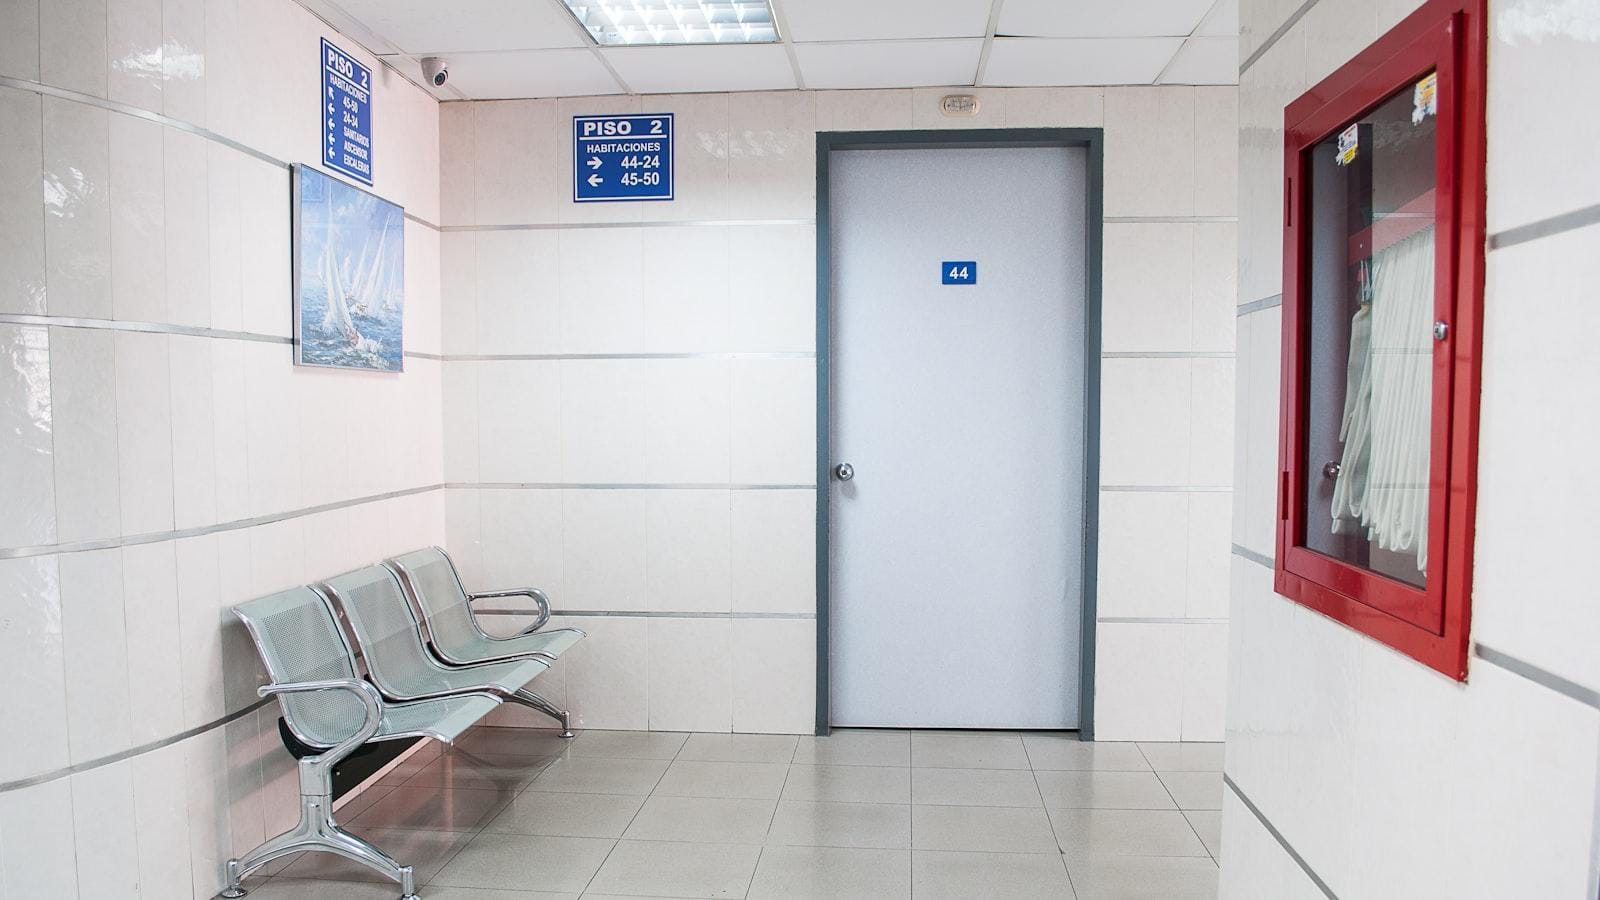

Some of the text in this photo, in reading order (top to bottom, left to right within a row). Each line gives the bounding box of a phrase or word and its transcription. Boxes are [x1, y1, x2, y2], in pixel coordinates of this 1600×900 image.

[328, 49, 368, 88] PISO 2
[330, 73, 367, 104] HABITACIONES
[342, 96, 358, 113] 45-50
[343, 111, 358, 128] 24-34
[584, 119, 662, 136] PISO 2
[343, 126, 370, 148] SANITARIOS
[343, 140, 368, 161] ASCENSOR
[586, 142, 661, 153] HABITACIONES
[343, 153, 370, 175] ESCALERAS
[620, 155, 660, 169] 44-24
[620, 172, 660, 186] 45-50
[949, 266, 969, 280] 44
